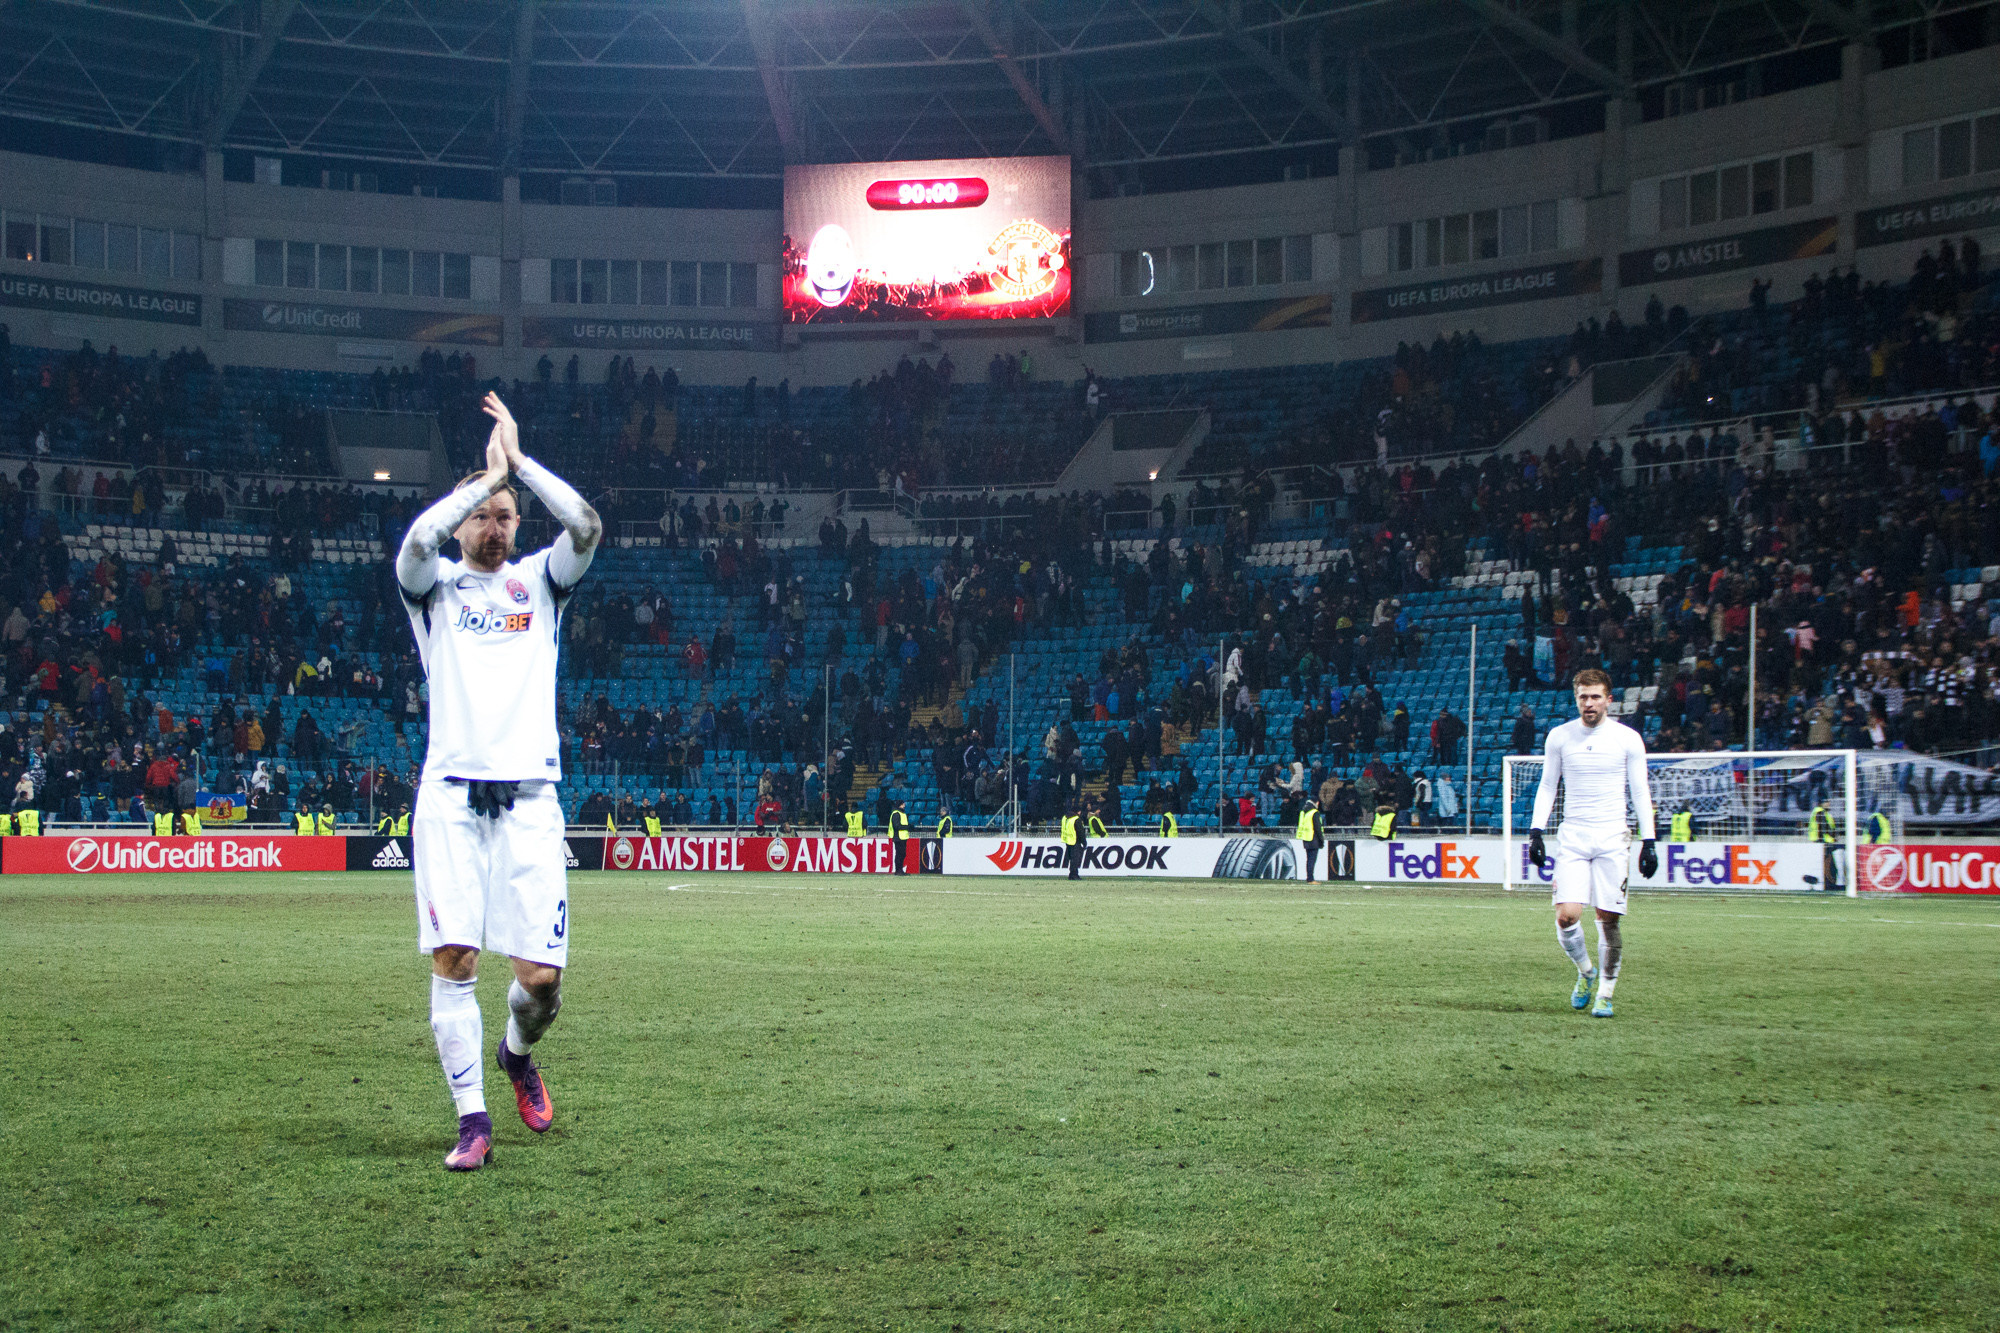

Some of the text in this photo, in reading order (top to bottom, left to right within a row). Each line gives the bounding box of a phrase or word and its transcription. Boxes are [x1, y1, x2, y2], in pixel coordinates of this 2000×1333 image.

[898, 182, 959, 204] 90:00
[1876, 210, 1926, 231] UEFA
[1674, 239, 1744, 268] AMSTEL
[1, 280, 196, 315] UEFA EUROPA LEAGUE
[1000, 278, 1047, 297] UNITED
[1387, 271, 1557, 308] UEFA EUROPA LEAGUE
[284, 306, 361, 330] UniCredit
[572, 325, 753, 341] UEFA EUROPA LEAGUE
[102, 841, 283, 869] UniCredit Bank
[372, 857, 410, 867] adidas
[637, 837, 745, 870] AMSTEL
[1388, 843, 1480, 879] FedEx
[1667, 845, 1778, 885] FedEx
